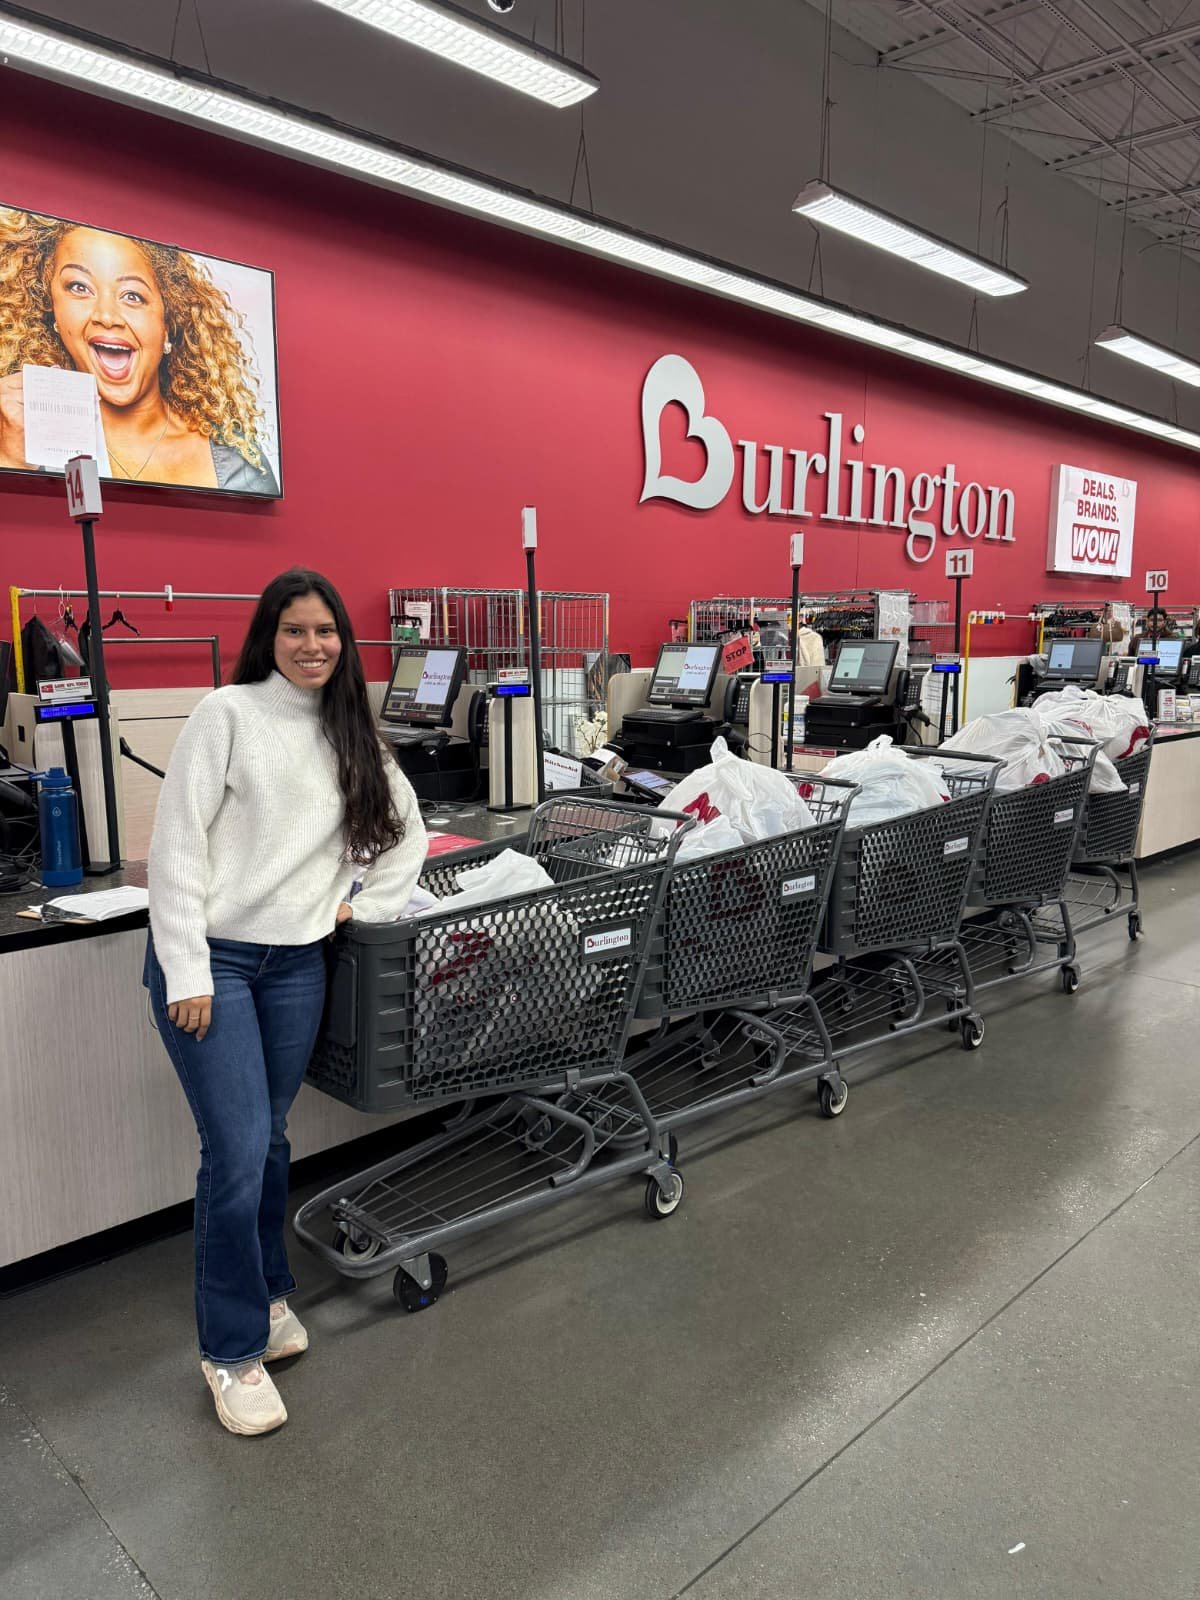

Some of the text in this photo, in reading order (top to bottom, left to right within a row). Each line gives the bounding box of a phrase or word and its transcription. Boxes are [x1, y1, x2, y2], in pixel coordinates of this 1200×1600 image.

[640, 354, 1016, 562] Burlington
[67, 469, 83, 508] 14
[1082, 478, 1117, 501] DEALS.
[1077, 498, 1119, 523] BRANDS.
[1072, 524, 1120, 564] WOW!
[949, 554, 967, 573] 11
[1149, 573, 1167, 588] 10
[725, 646, 747, 662] STOP
[544, 758, 578, 773] KitchenAid
[586, 934, 629, 949] Burlington
